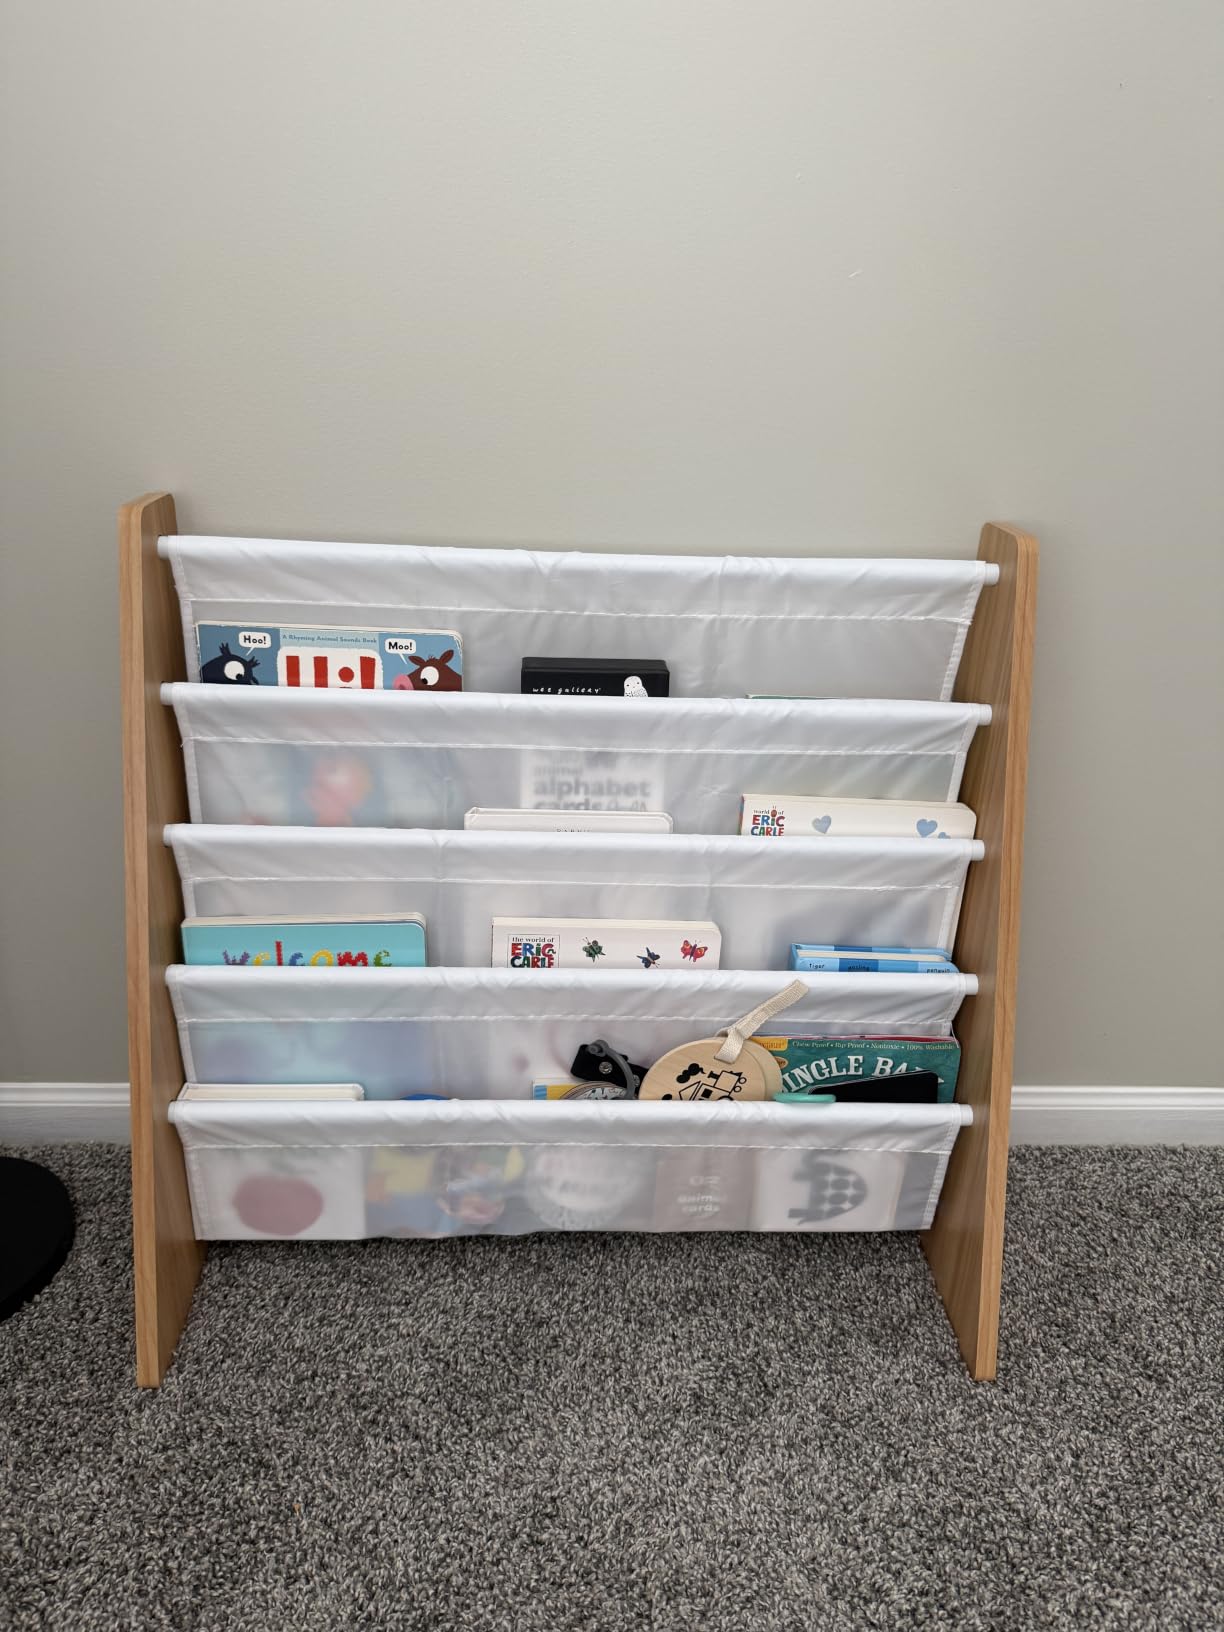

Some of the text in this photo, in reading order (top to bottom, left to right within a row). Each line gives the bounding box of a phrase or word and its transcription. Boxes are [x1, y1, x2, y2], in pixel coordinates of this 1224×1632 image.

[244, 635, 266, 645] Hoo!
[289, 634, 315, 642] Rhyming
[388, 641, 412, 651] Moo!
[557, 686, 600, 695] gallery
[533, 776, 651, 801] alphabet
[751, 826, 785, 836] CARLE
[511, 956, 555, 968] CARLE
[782, 1055, 864, 1093] INGLE
